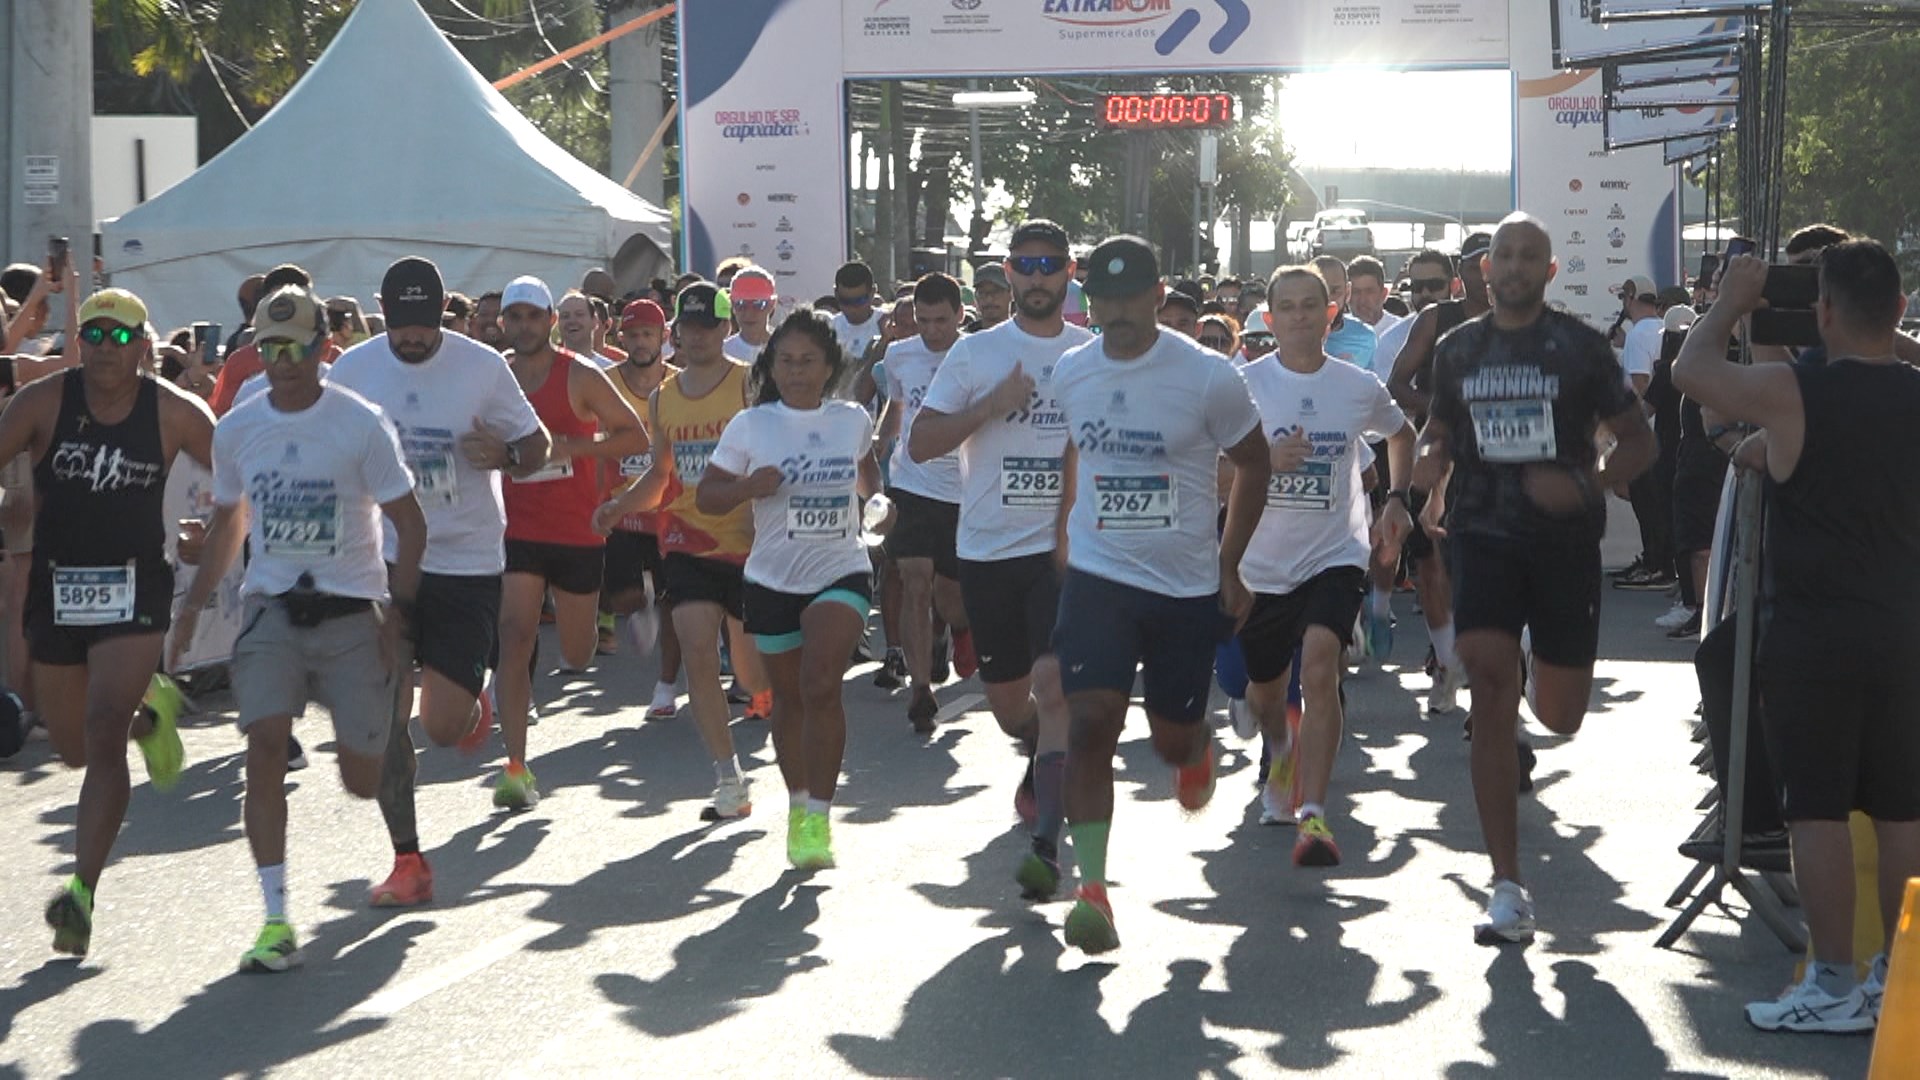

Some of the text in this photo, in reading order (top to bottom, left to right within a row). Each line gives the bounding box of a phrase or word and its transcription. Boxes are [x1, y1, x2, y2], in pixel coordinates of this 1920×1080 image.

[1058, 28, 1156, 40] Supermercados
[1106, 96, 1228, 122] 00:00:07
[1548, 96, 1596, 111] ORGULHO
[715, 109, 800, 126] ORGULHO DE SER
[722, 122, 795, 141] capixaba
[1007, 473, 1060, 491] 2982
[1101, 492, 1153, 513] 2967
[796, 510, 838, 527] 1098
[60, 587, 112, 605] 5895
